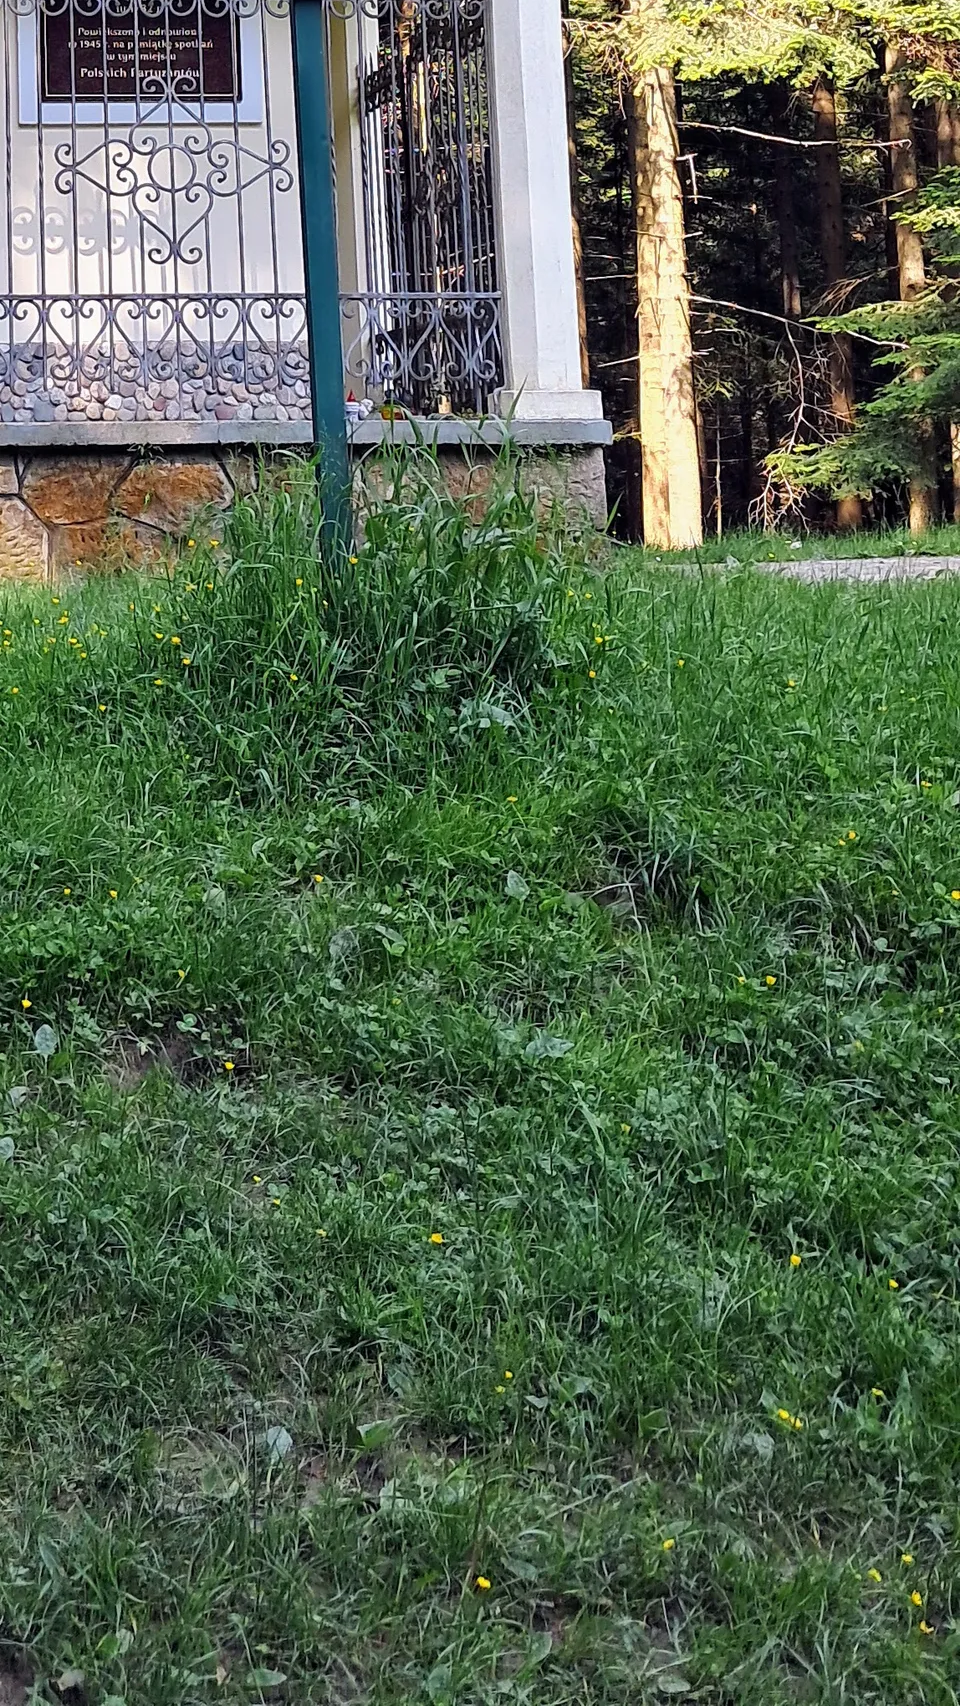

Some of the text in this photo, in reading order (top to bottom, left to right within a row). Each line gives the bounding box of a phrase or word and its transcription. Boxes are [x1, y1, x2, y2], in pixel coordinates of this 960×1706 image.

[78, 27, 140, 36] Powikszon
[148, 27, 203, 36] odnowion
[79, 40, 102, 49] 1945
[113, 41, 125, 49] na
[127, 39, 172, 51] pmiątkę
